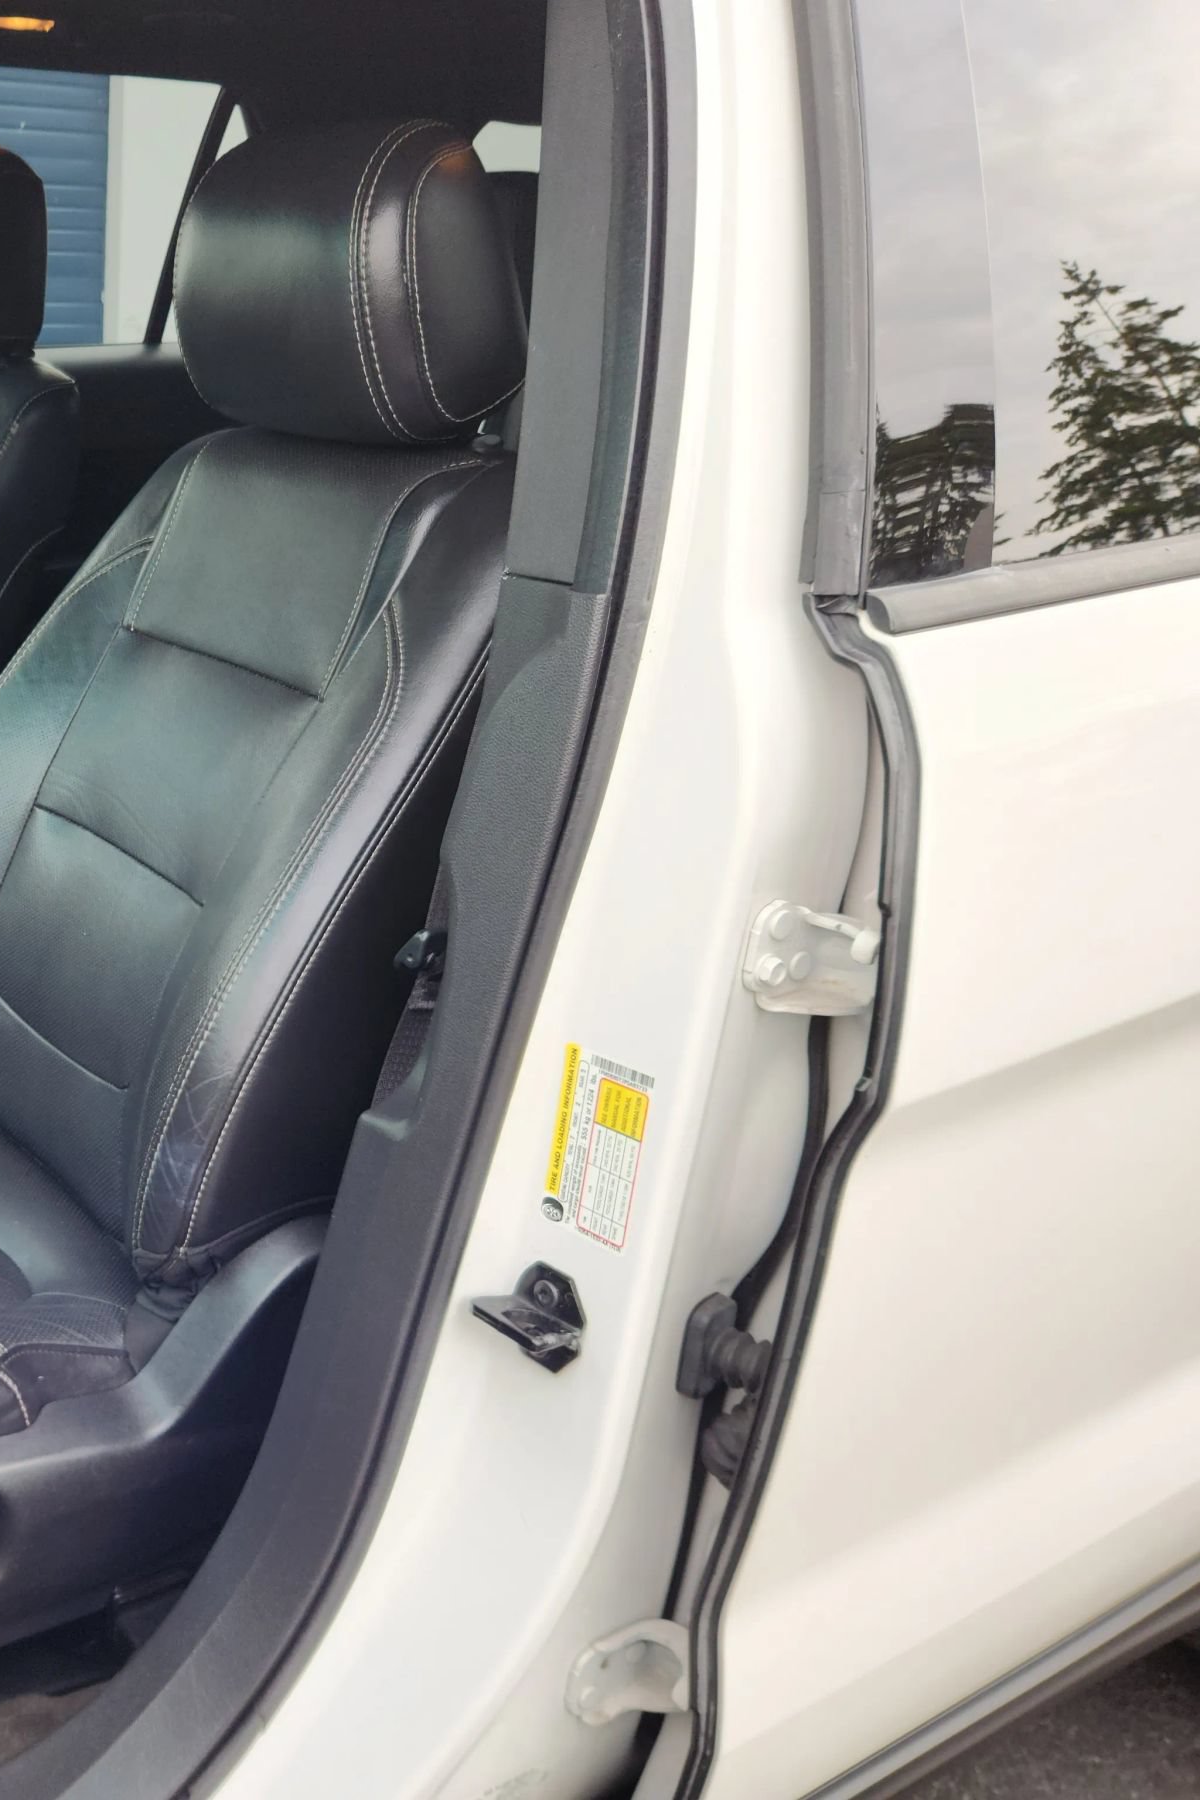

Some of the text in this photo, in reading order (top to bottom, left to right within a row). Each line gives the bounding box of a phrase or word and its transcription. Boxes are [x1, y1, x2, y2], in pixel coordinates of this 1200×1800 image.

[549, 1172, 557, 1190] TIRE
[556, 1112, 567, 1149] LOADING
[563, 1048, 577, 1109] INFORMATION
[584, 1116, 591, 1124] kg
